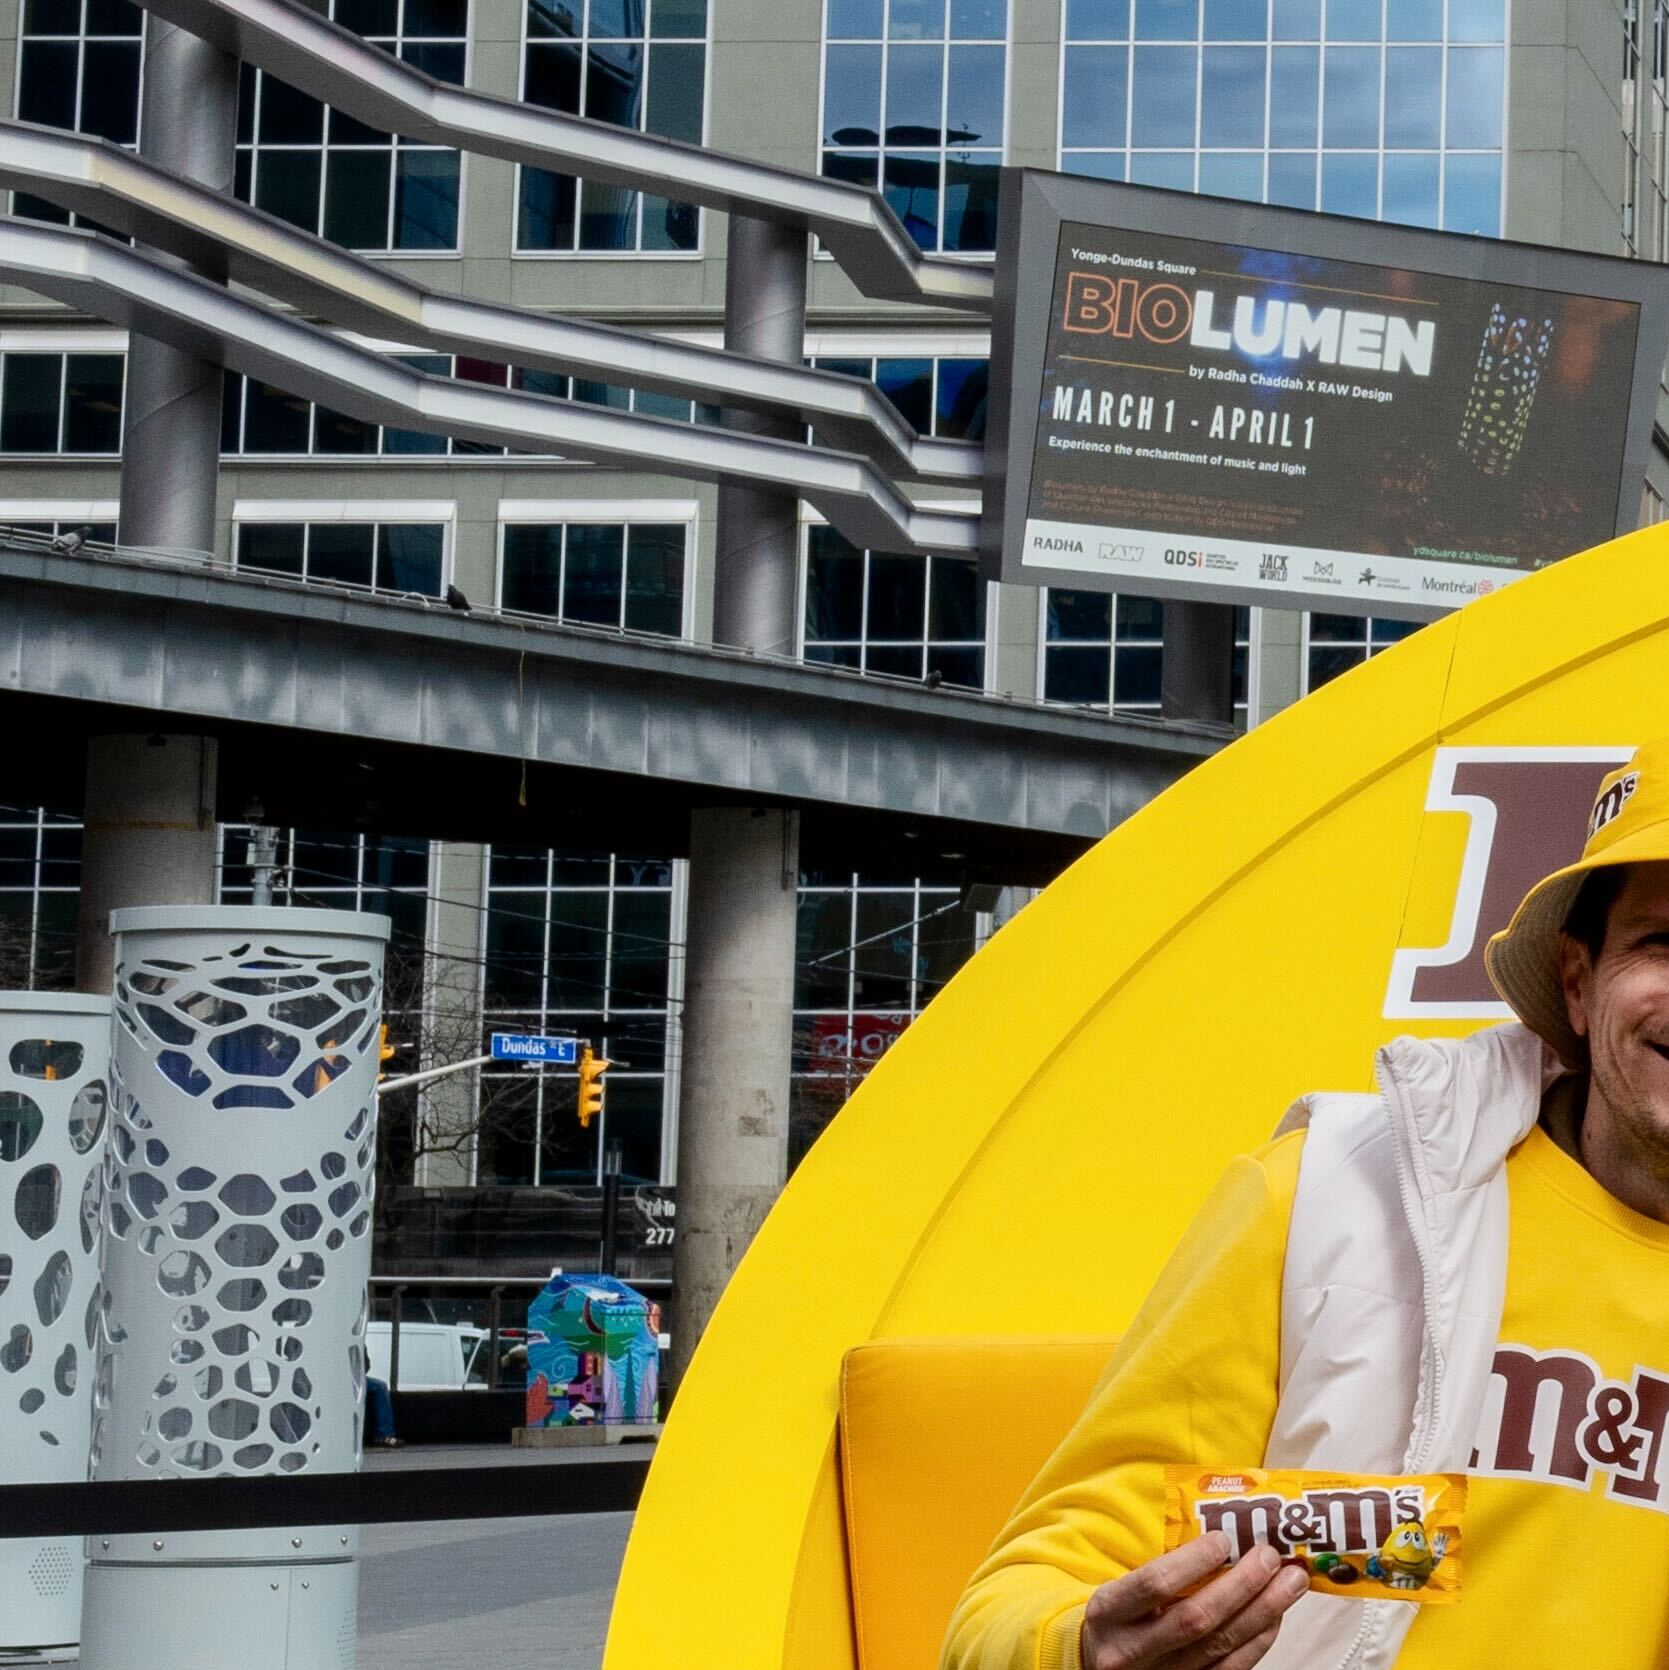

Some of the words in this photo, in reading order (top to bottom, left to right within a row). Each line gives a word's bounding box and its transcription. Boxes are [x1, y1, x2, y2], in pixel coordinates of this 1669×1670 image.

[1071, 248, 1154, 270] Yonge-Dundas
[1156, 261, 1197, 276] Square
[1063, 271, 1436, 377] BIOLUMEN
[1189, 365, 1205, 379] by
[1208, 365, 1247, 384] Radha
[1250, 370, 1303, 391] Chaddah
[1318, 382, 1350, 396] RAW
[1352, 385, 1394, 402] Design
[1052, 385, 1154, 431] MARCH
[1165, 400, 1175, 433] 1
[1209, 405, 1293, 448] APRIL
[1304, 416, 1315, 449] 1
[1049, 435, 1112, 453] Experience
[1114, 444, 1133, 456] the
[1135, 447, 1208, 465] enchantment
[1210, 455, 1223, 466] of
[1224, 457, 1256, 470] music
[1258, 460, 1279, 473] and
[1281, 462, 1307, 476] light
[1033, 536, 1084, 554] RADHA
[1164, 548, 1203, 569] QDSi
[1422, 576, 1477, 594] Montréal
[501, 1037, 546, 1056] Dundas
[645, 1228, 675, 1245] 277
